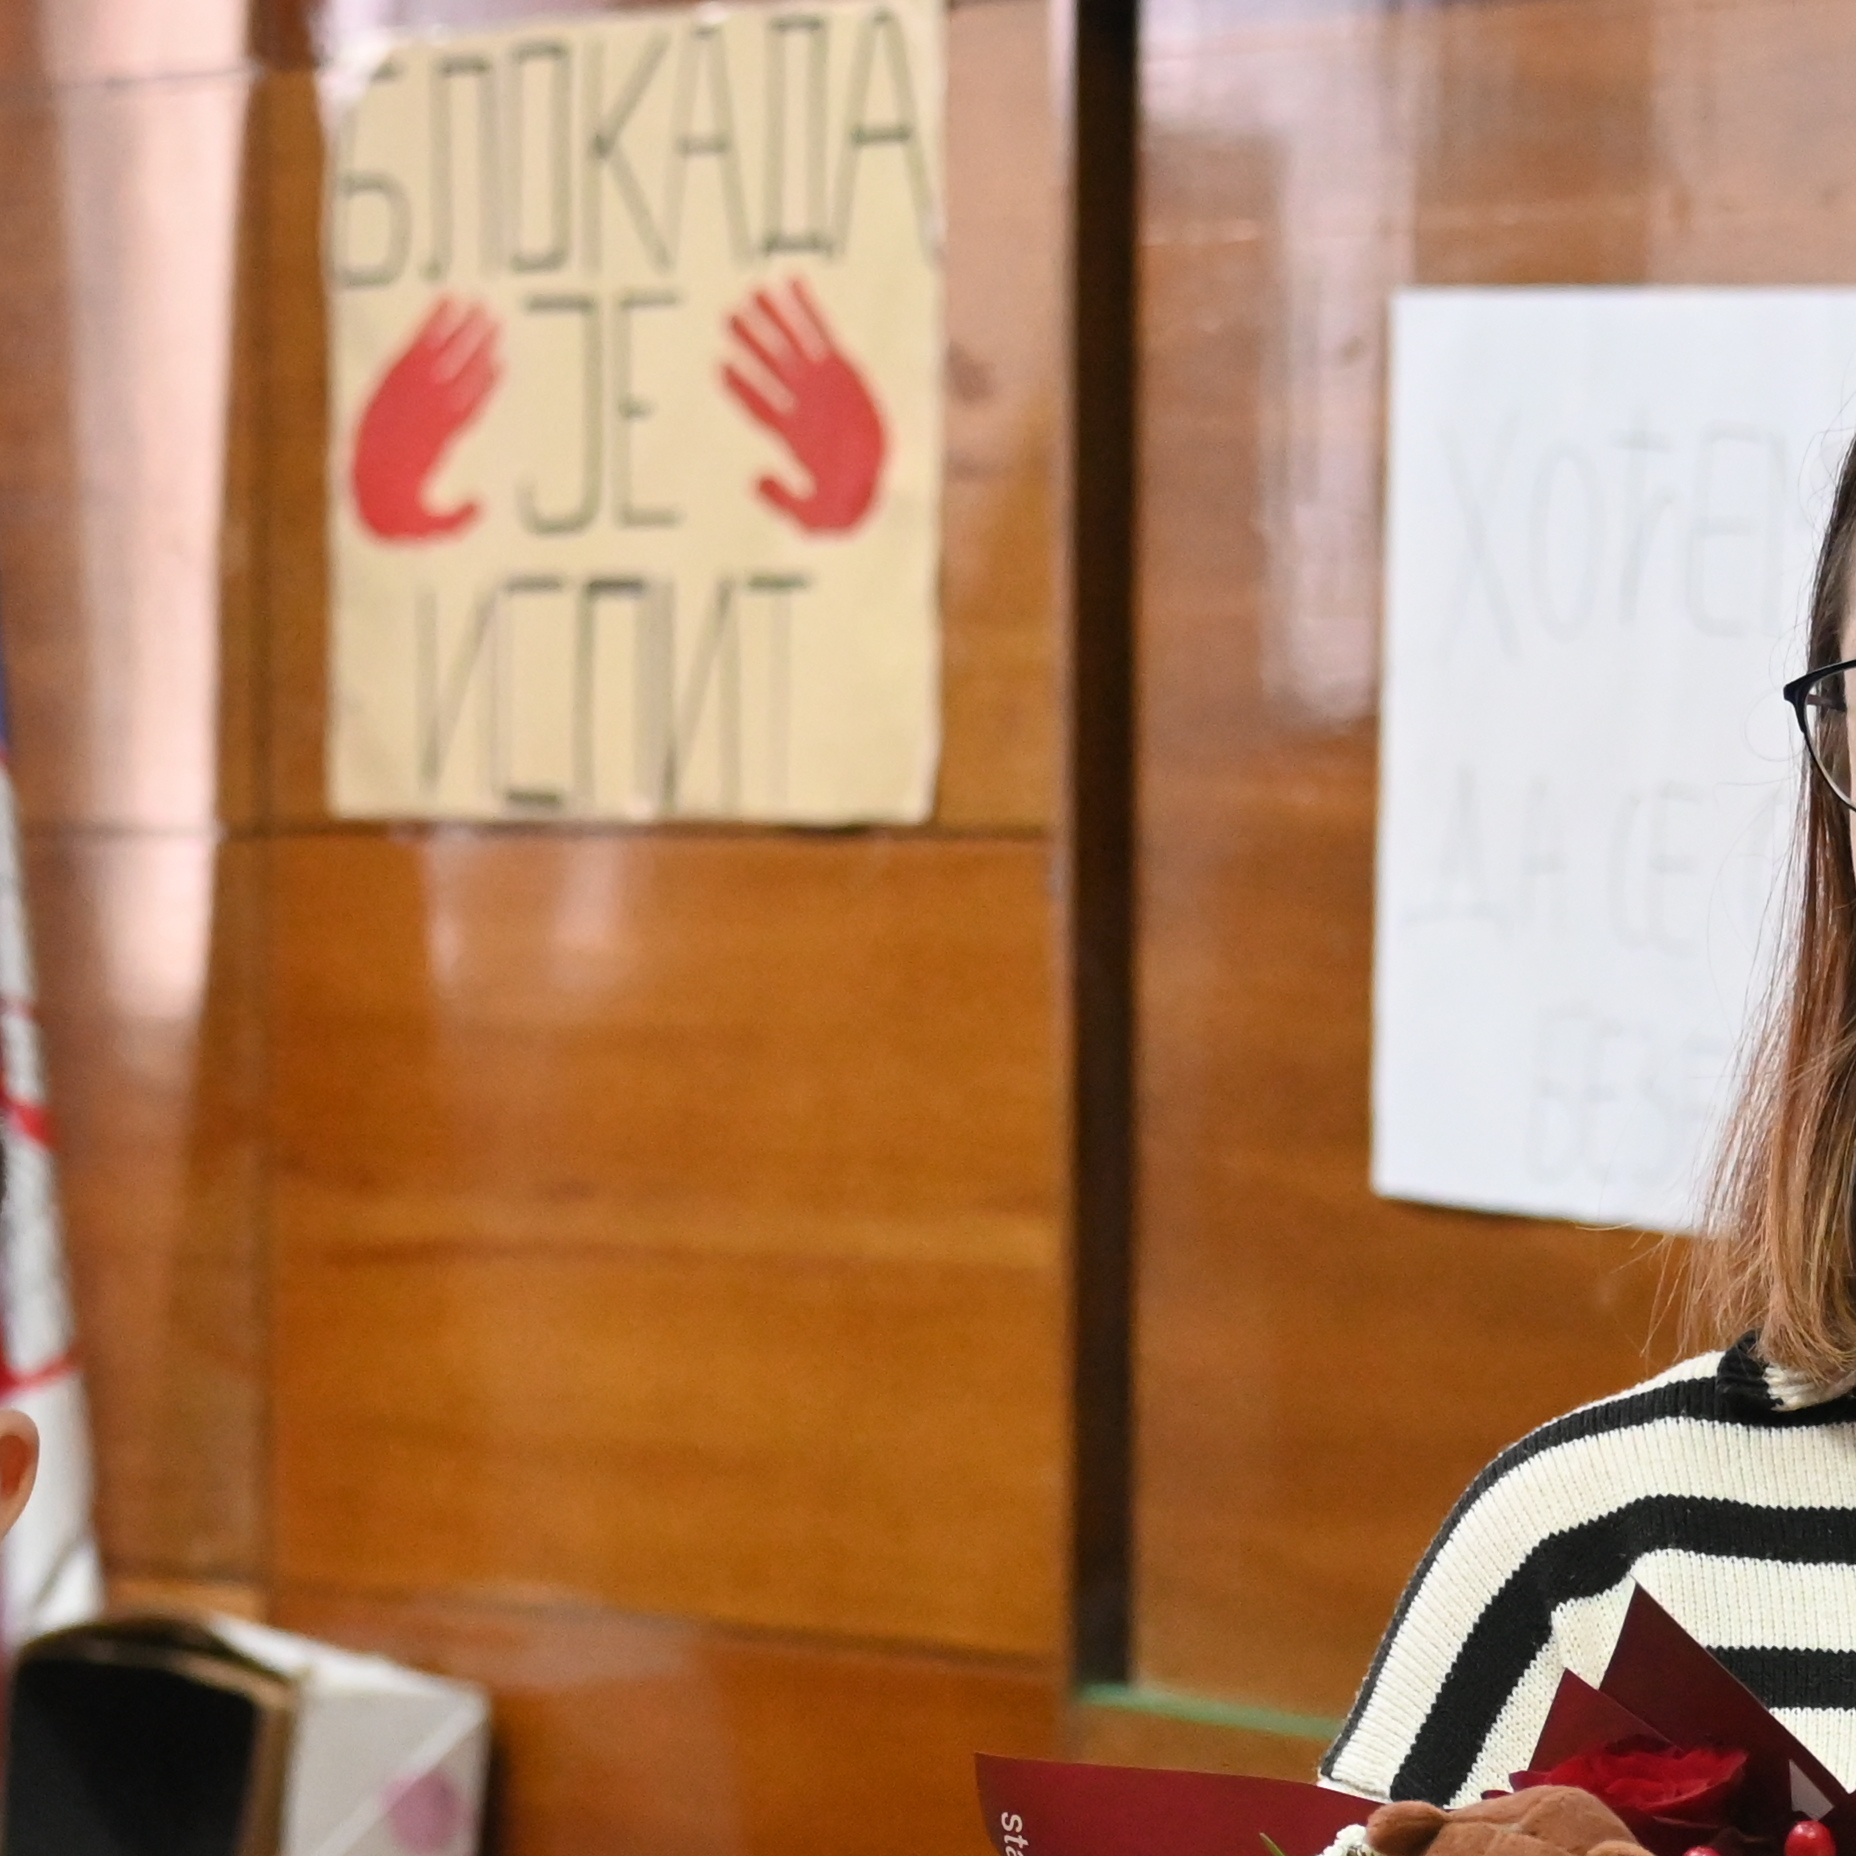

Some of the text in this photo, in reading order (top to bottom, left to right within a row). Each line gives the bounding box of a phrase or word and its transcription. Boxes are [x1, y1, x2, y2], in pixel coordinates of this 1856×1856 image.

[332, 10, 941, 289] БЛОКАДА
[516, 290, 684, 538] ЈЕ
[412, 574, 812, 815] ИСПИТ
